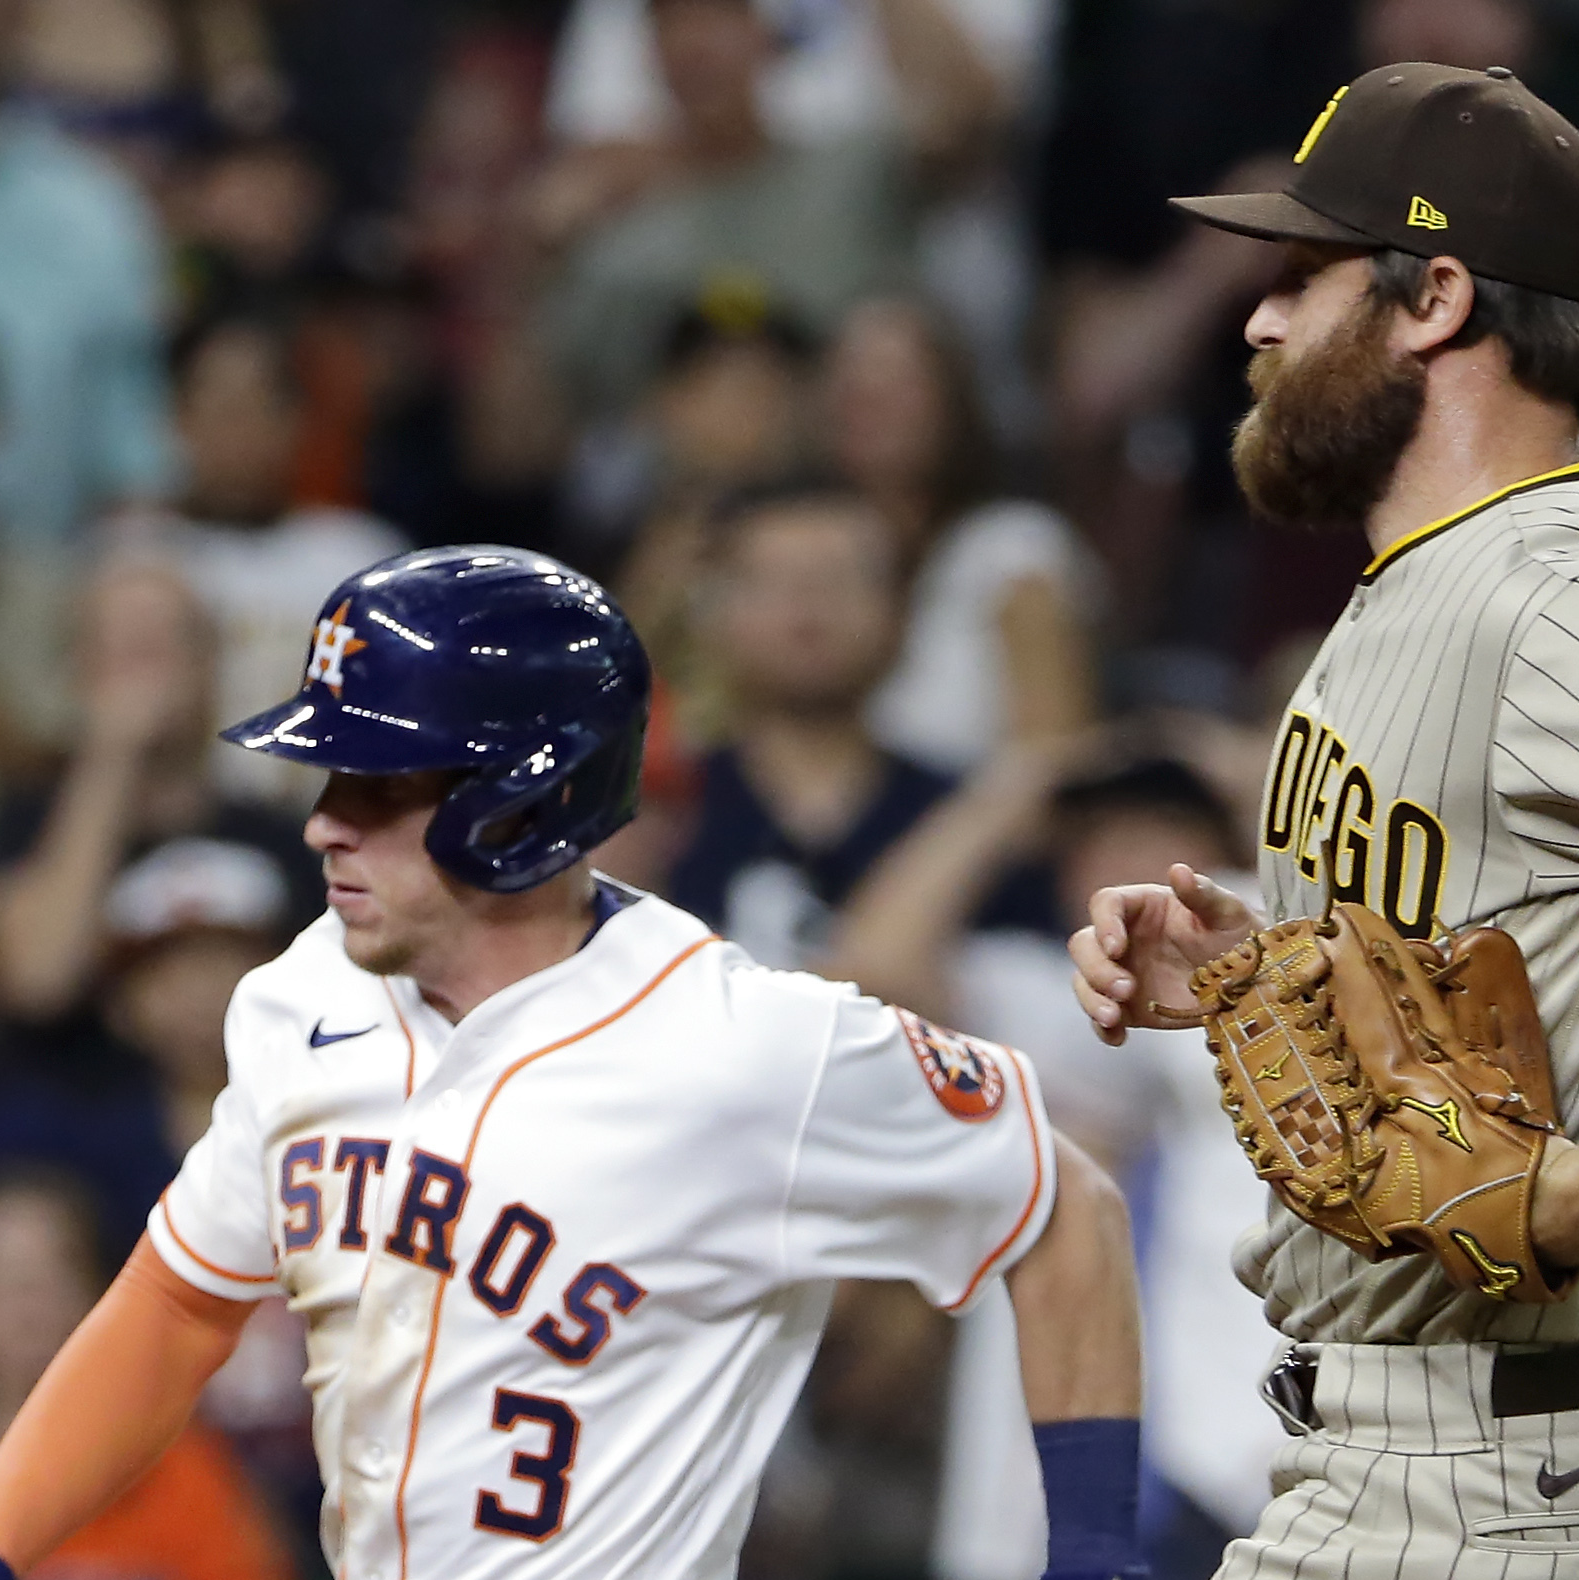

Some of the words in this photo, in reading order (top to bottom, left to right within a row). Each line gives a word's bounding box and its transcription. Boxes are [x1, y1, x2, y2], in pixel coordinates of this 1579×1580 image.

[306, 618, 356, 688] H
[1263, 709, 1450, 940] DIEGO
[273, 1136, 648, 1367] STROS
[473, 1386, 583, 1544] 3
